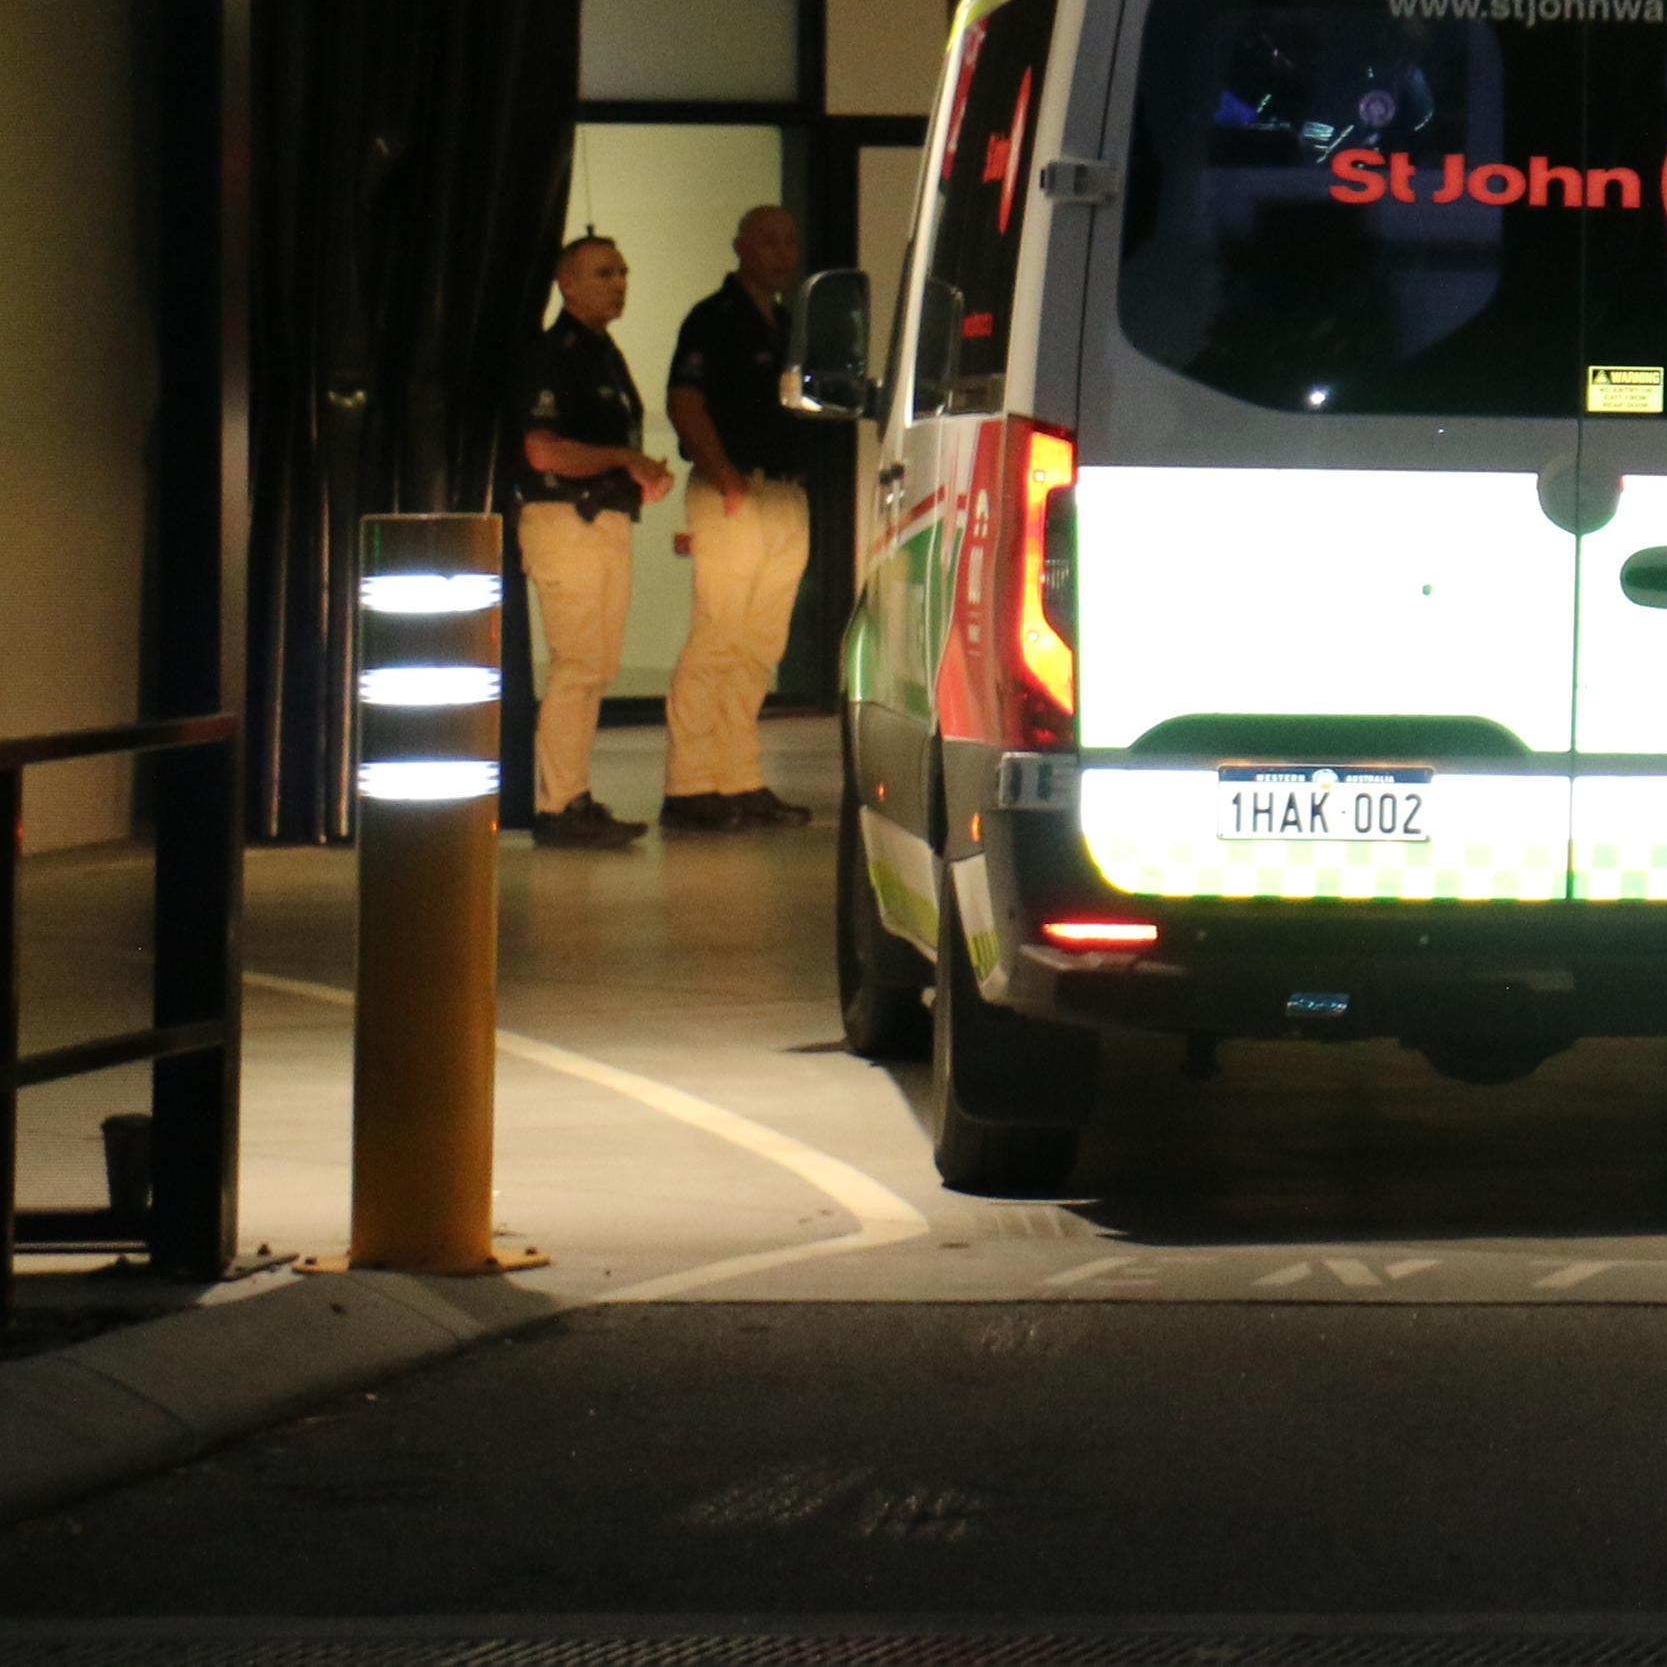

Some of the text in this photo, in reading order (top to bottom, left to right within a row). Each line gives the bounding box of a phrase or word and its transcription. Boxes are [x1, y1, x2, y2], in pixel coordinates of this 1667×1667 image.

[1330, 149, 1642, 209] St John
[1611, 372, 1659, 383] WARNING
[1255, 774, 1396, 783] WESTERN AUSTRALIA
[1231, 792, 1423, 835] 1HAK 002
